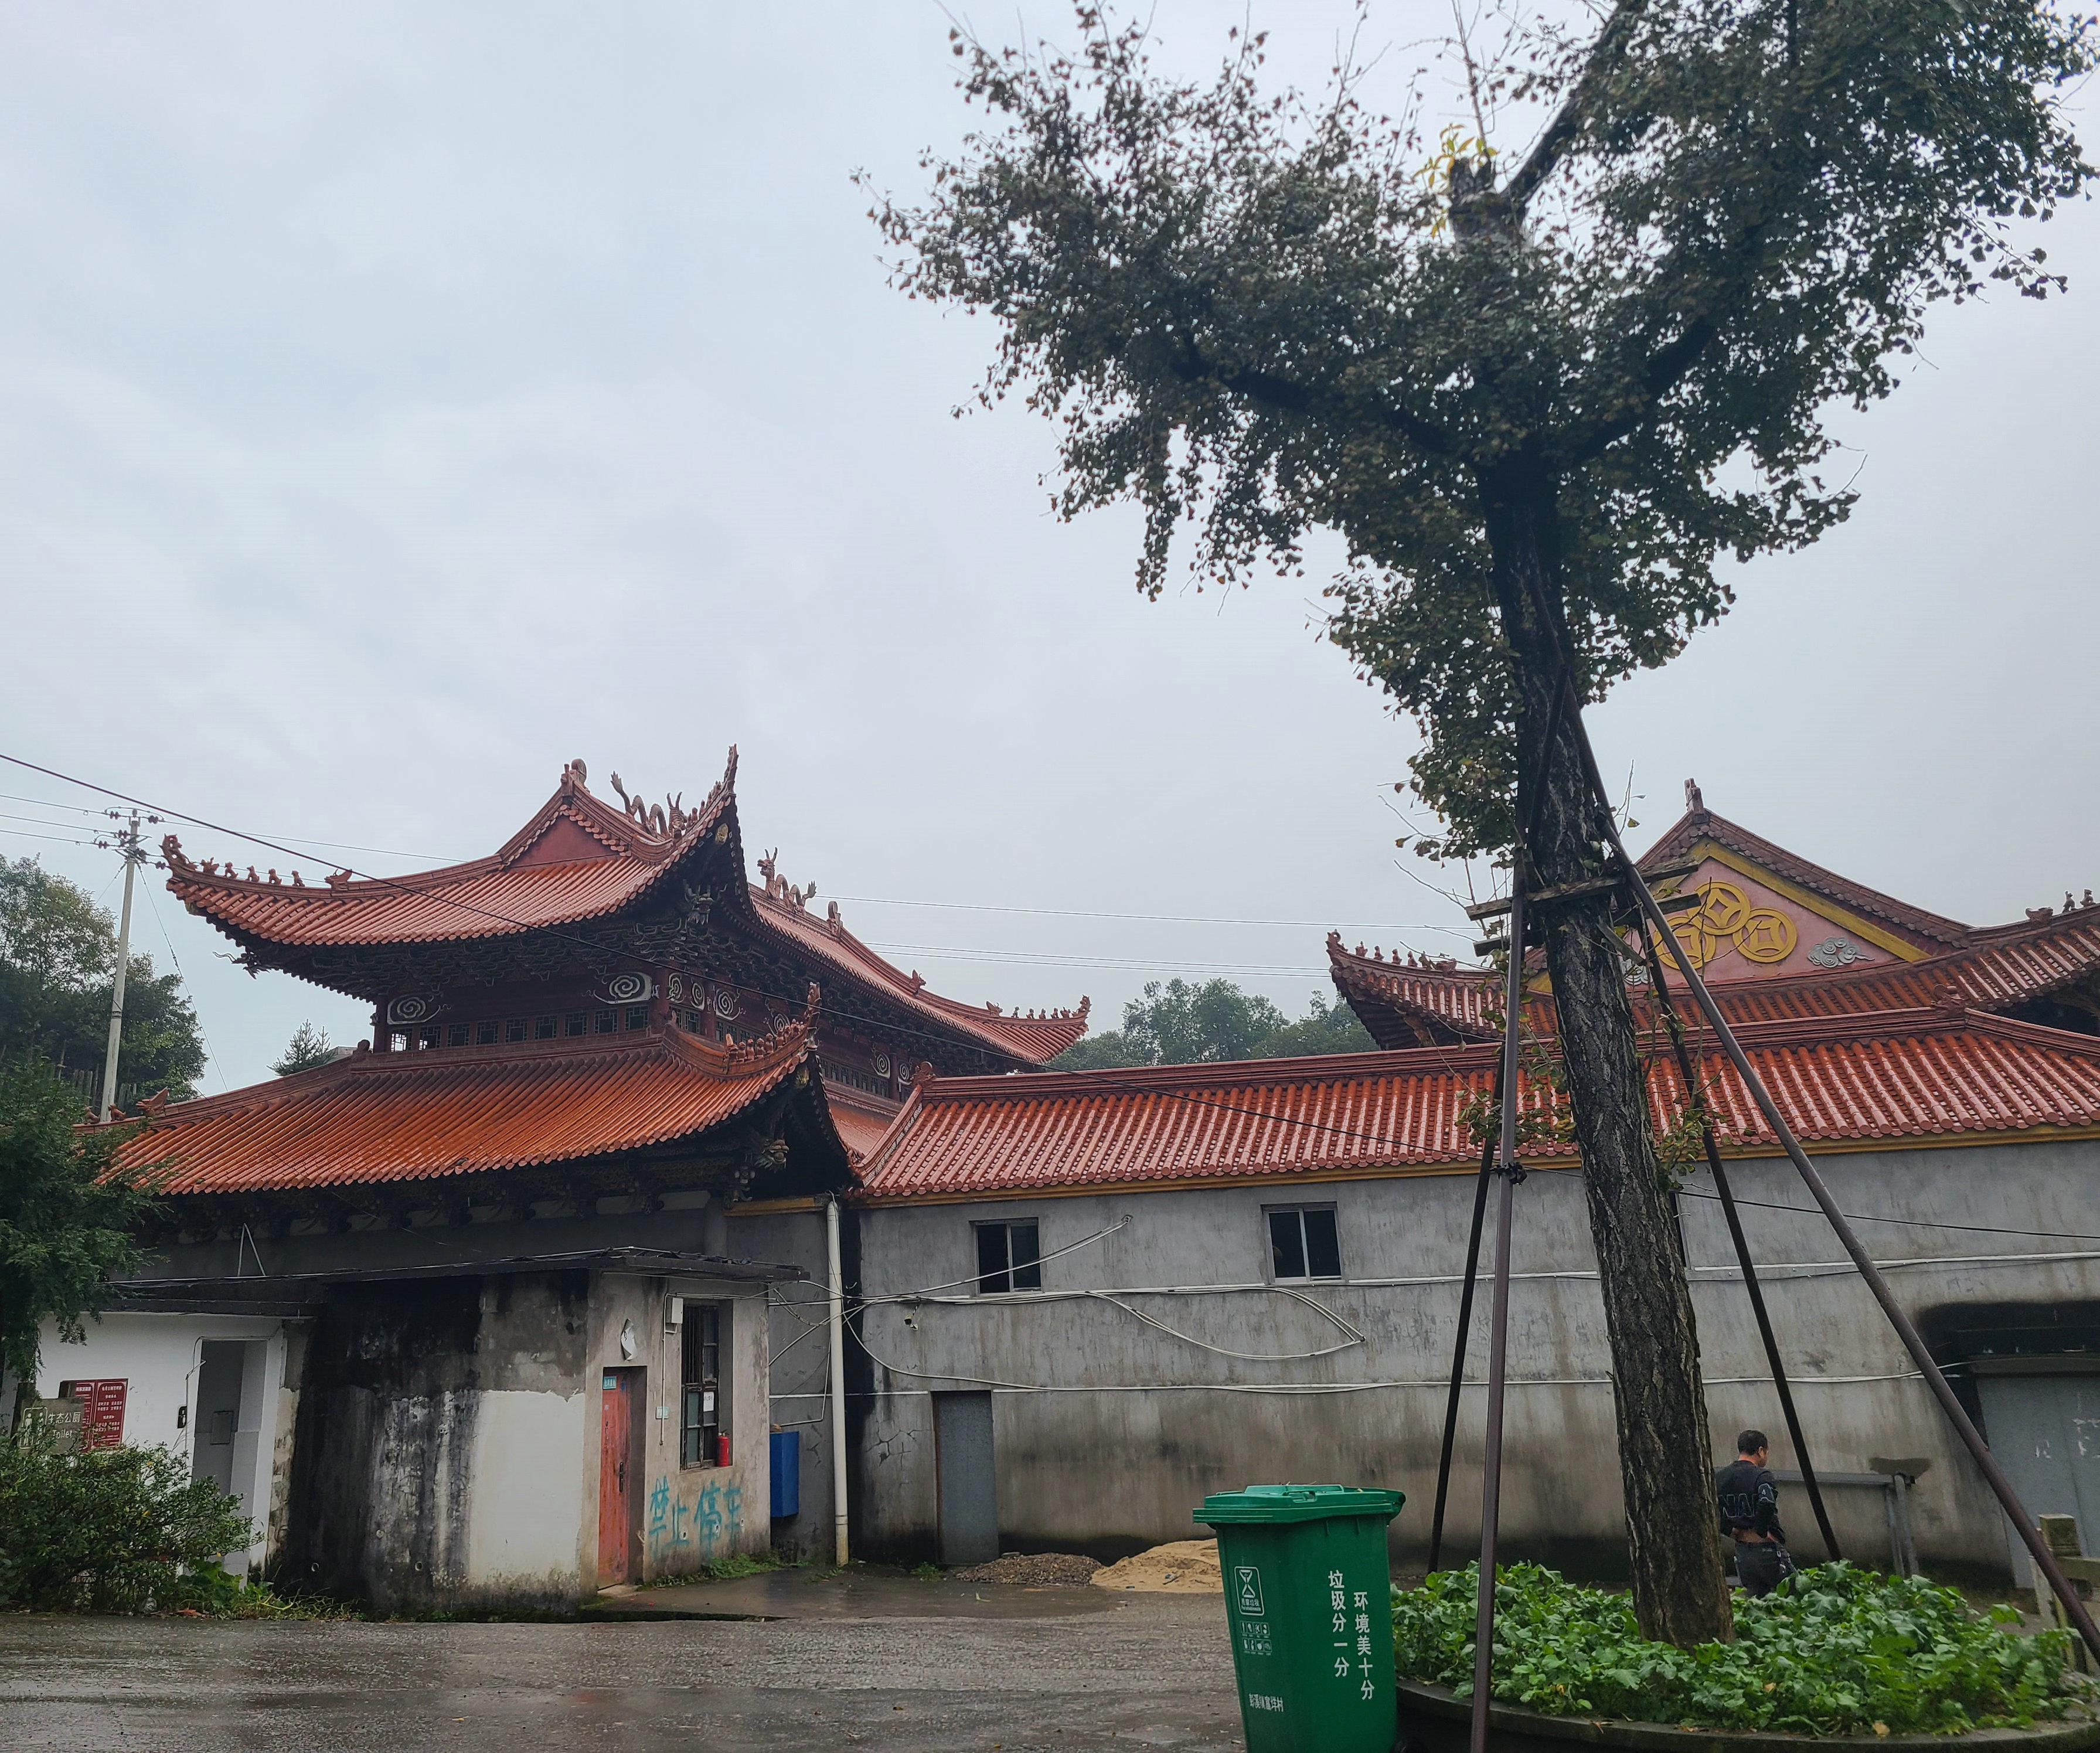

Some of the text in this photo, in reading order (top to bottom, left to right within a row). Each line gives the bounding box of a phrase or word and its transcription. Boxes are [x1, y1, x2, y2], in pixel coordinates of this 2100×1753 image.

[47, 1411, 81, 1424] 生态公厕
[53, 1429, 73, 1439] Toilet
[649, 1476, 741, 1562] 禁止停车
[1328, 1570, 1350, 1677] 垃圾分一分
[1353, 1591, 1375, 1700] 环境美十分
